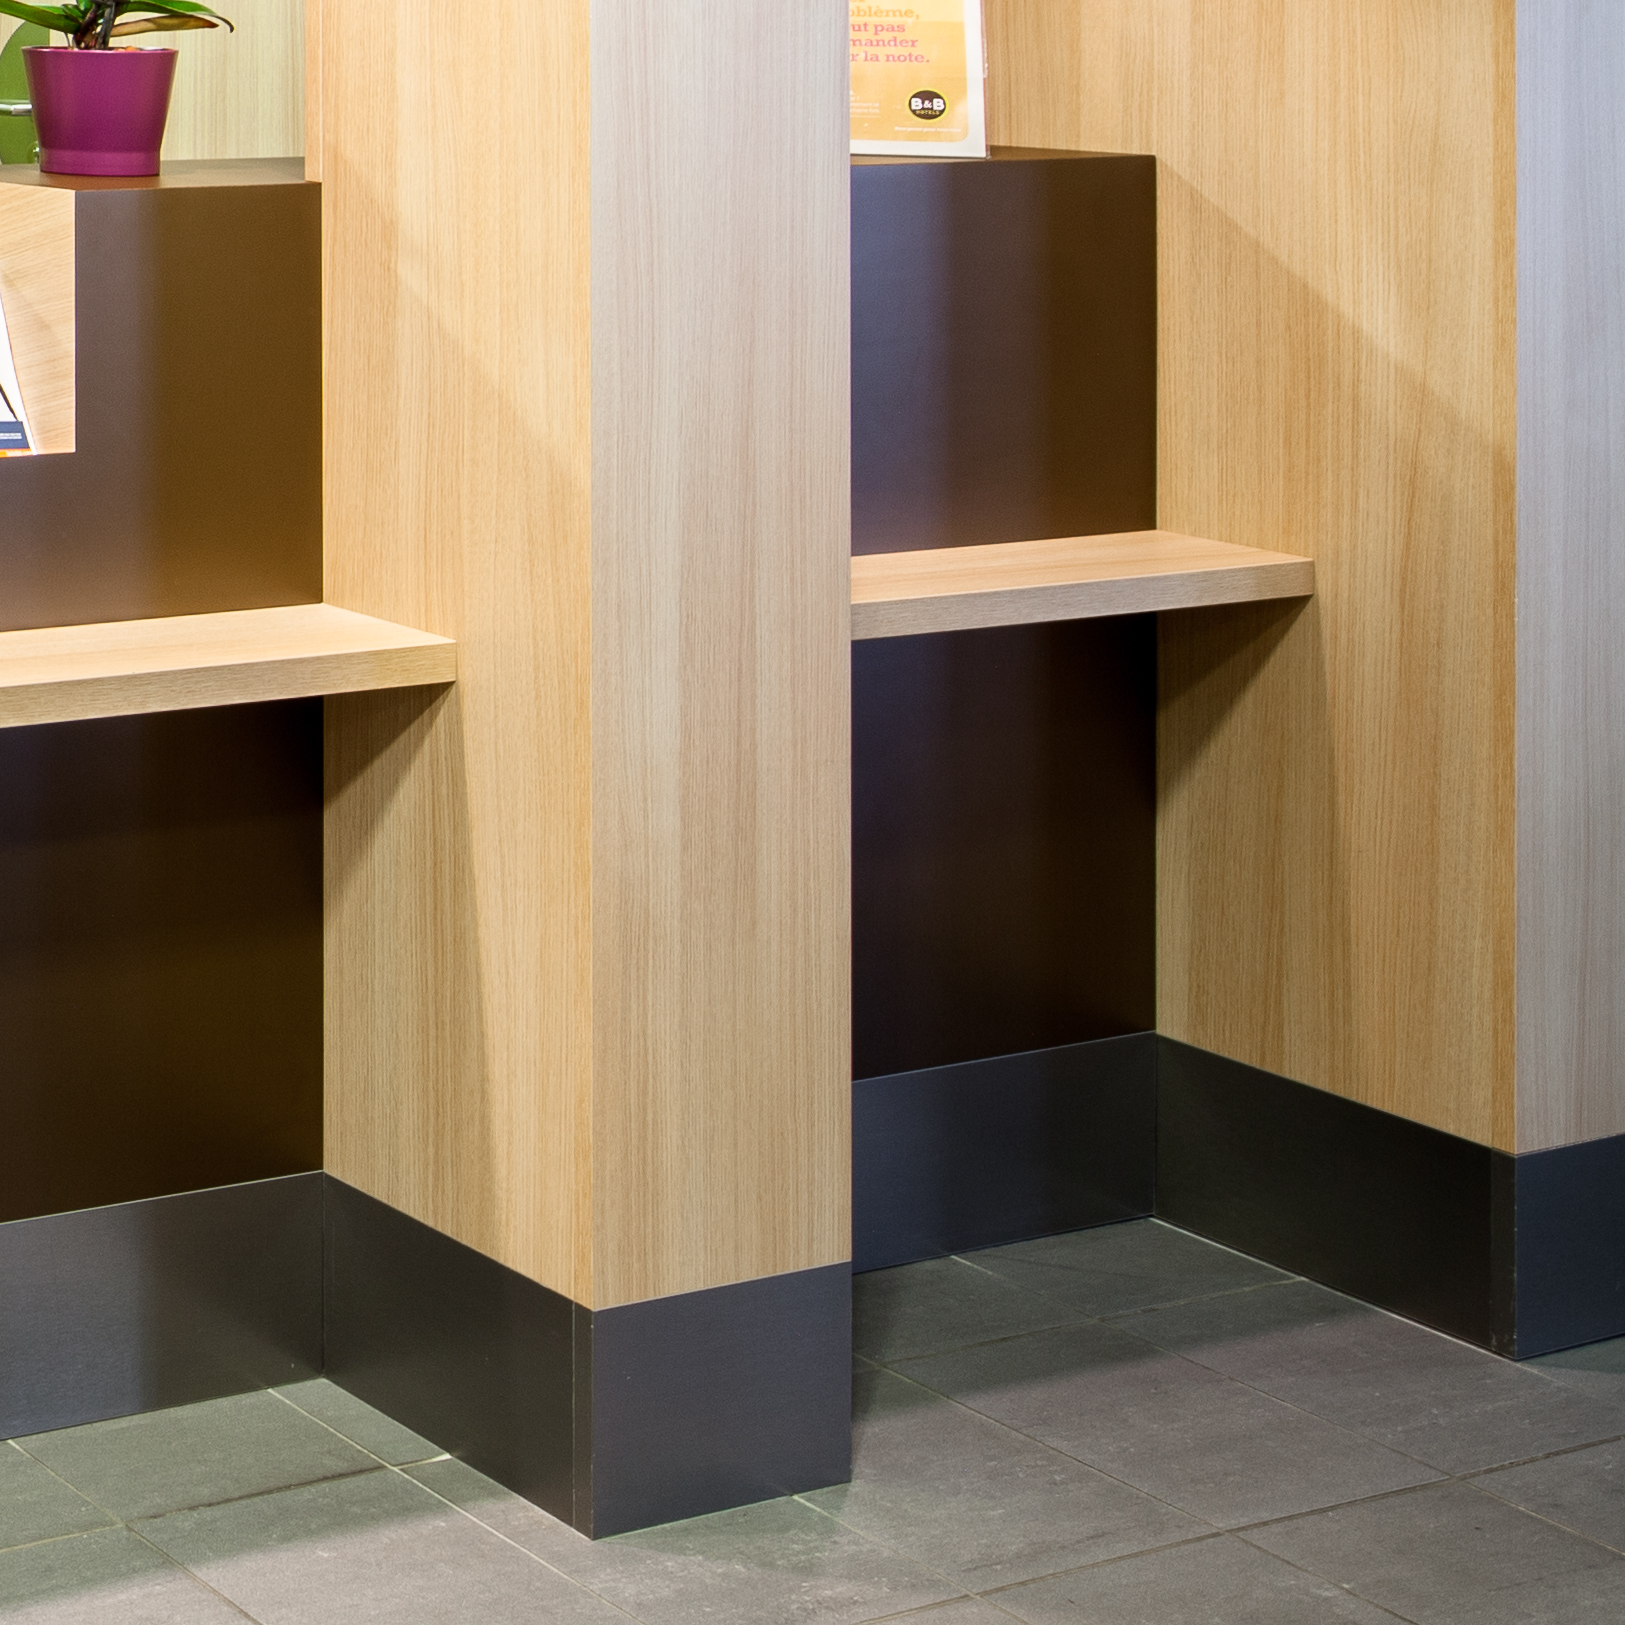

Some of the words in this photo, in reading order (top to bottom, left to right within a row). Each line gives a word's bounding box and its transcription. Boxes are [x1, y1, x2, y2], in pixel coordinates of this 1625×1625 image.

[874, 24, 905, 35] pas
[863, 51, 880, 62] la
[885, 52, 930, 62] note.
[911, 98, 944, 110] B&B
